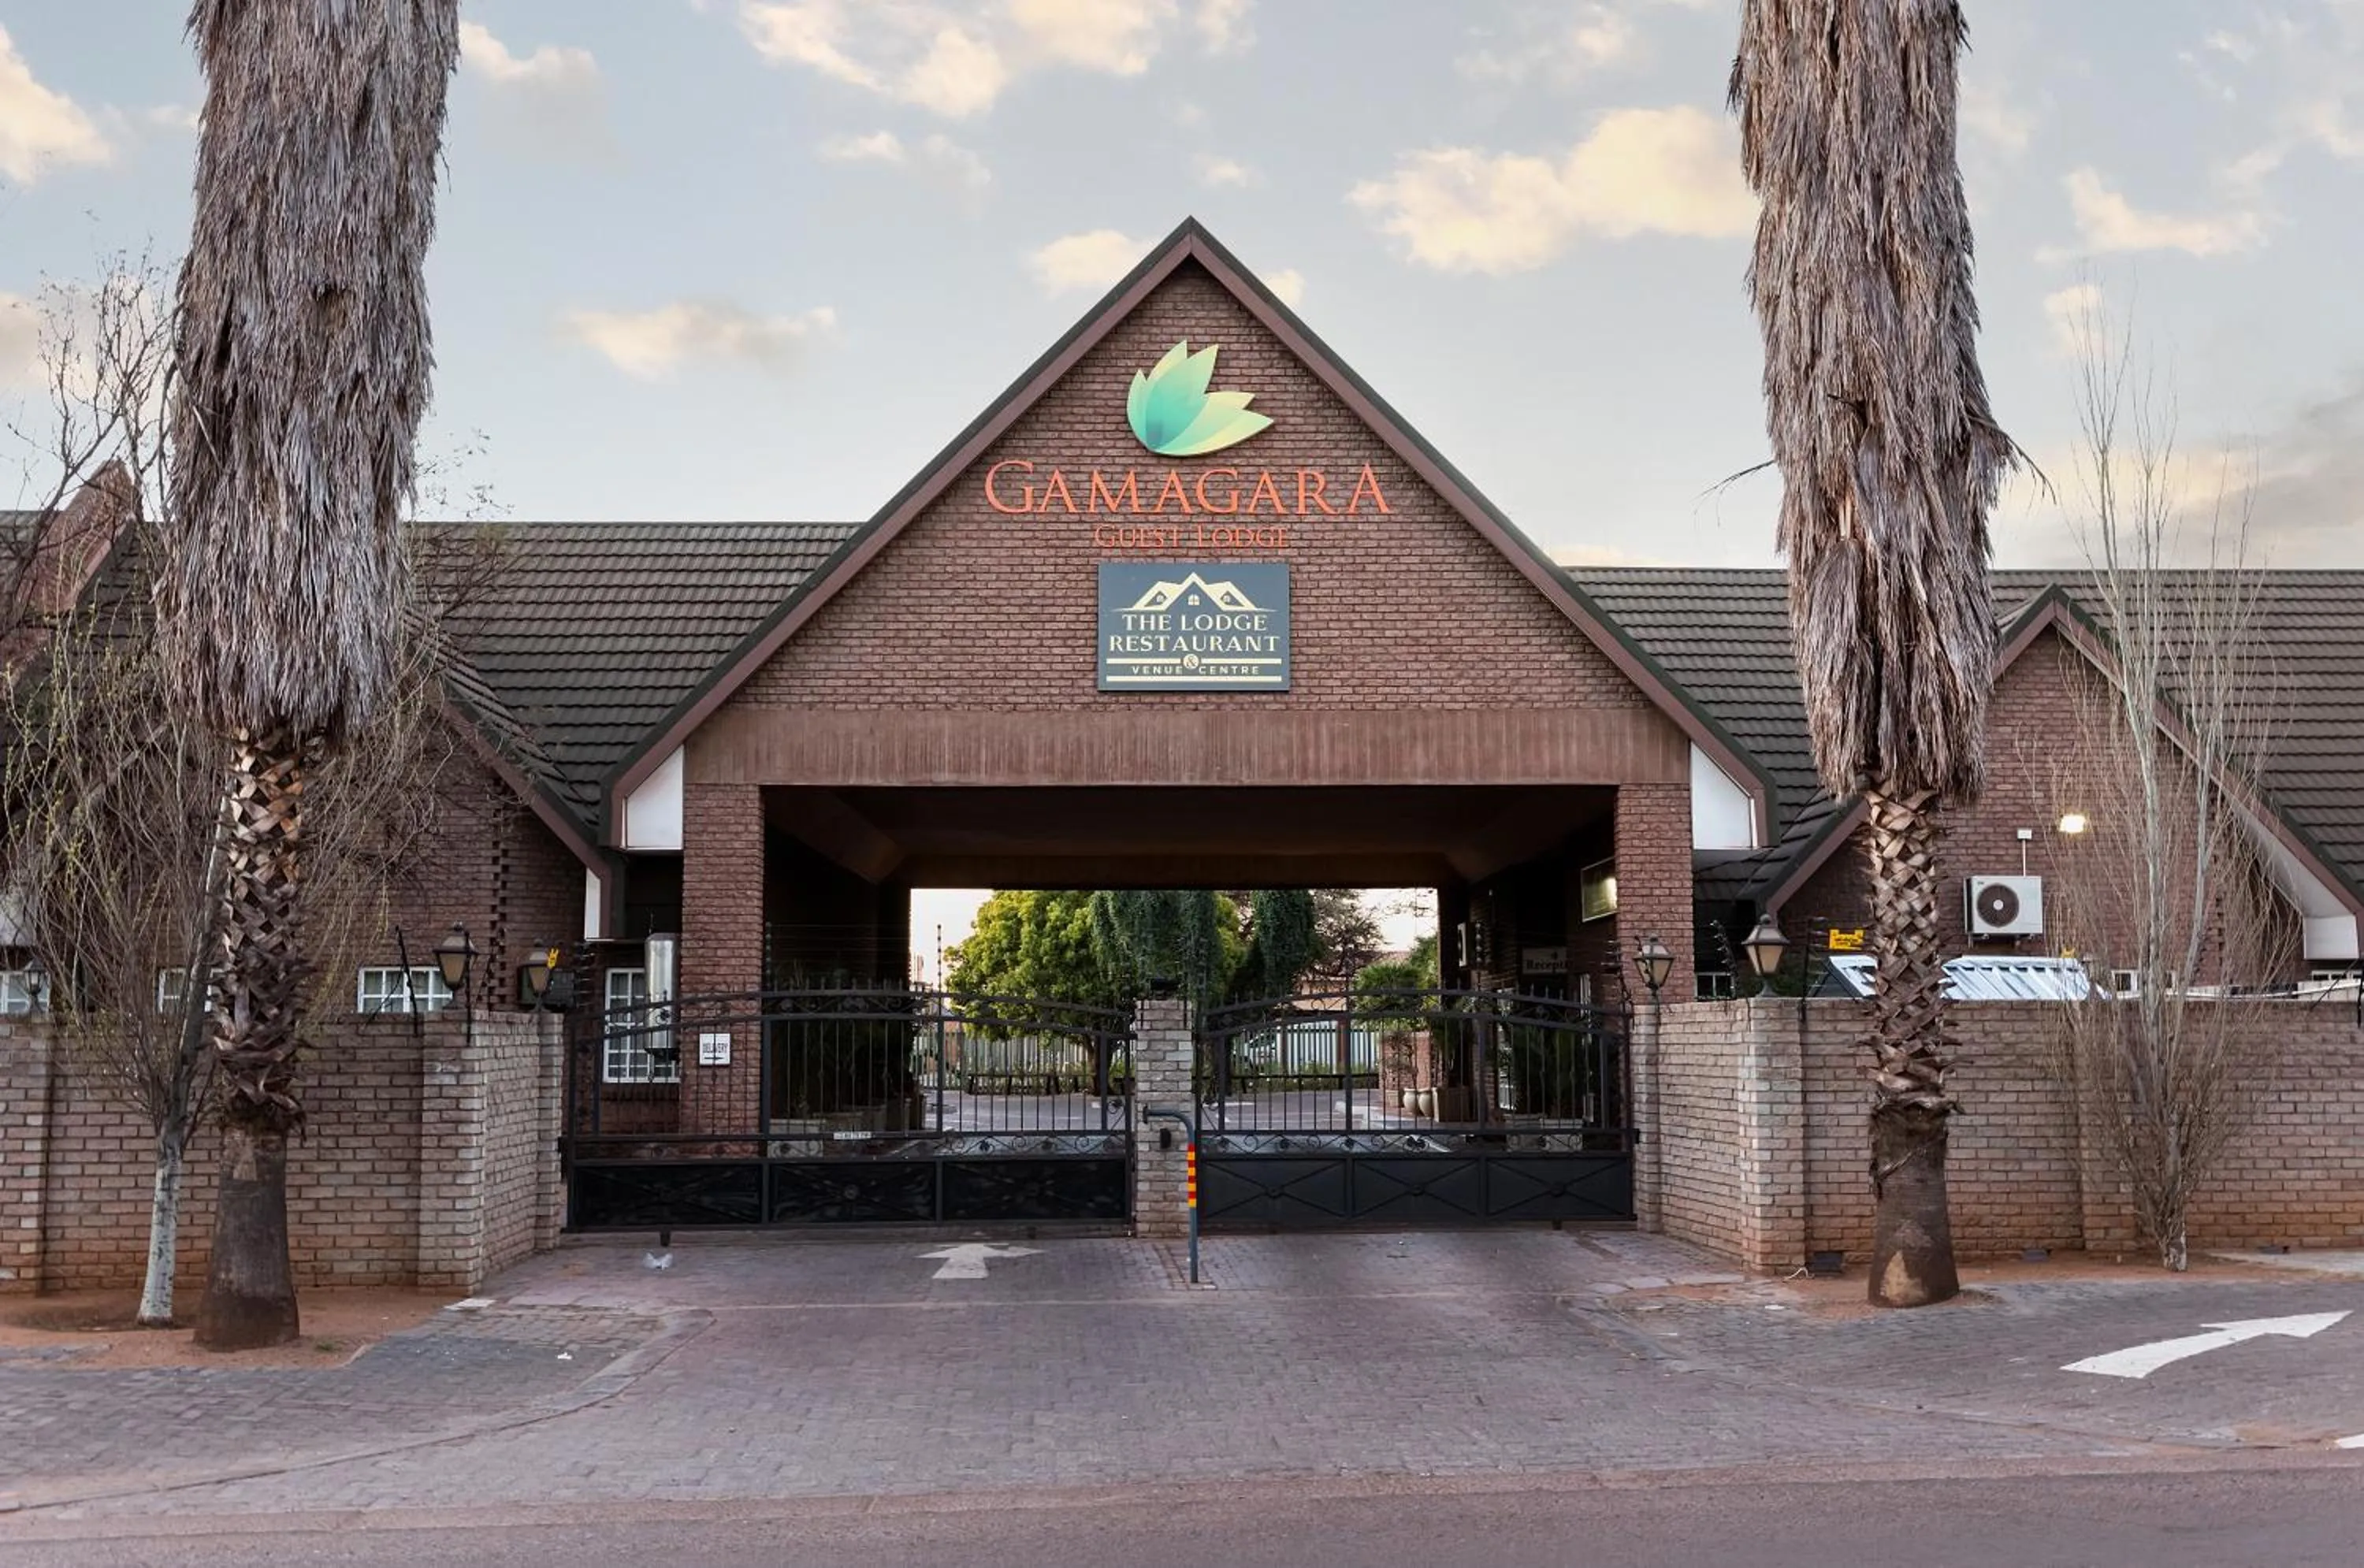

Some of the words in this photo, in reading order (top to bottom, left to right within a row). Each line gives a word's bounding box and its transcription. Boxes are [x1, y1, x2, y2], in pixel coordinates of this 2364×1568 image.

[984, 460, 1391, 515] GAMAGARA
[1095, 524, 1180, 548] GUEST
[1197, 523, 1289, 548] LODGE
[1122, 615, 1172, 631] THE
[1181, 614, 1268, 631] LODGE
[1109, 634, 1280, 652] RESTAURANT
[1132, 665, 1184, 675] VENUE
[1184, 655, 1198, 668] &
[1199, 665, 1260, 675] CENTRE
[702, 1042, 729, 1053] DELERY
